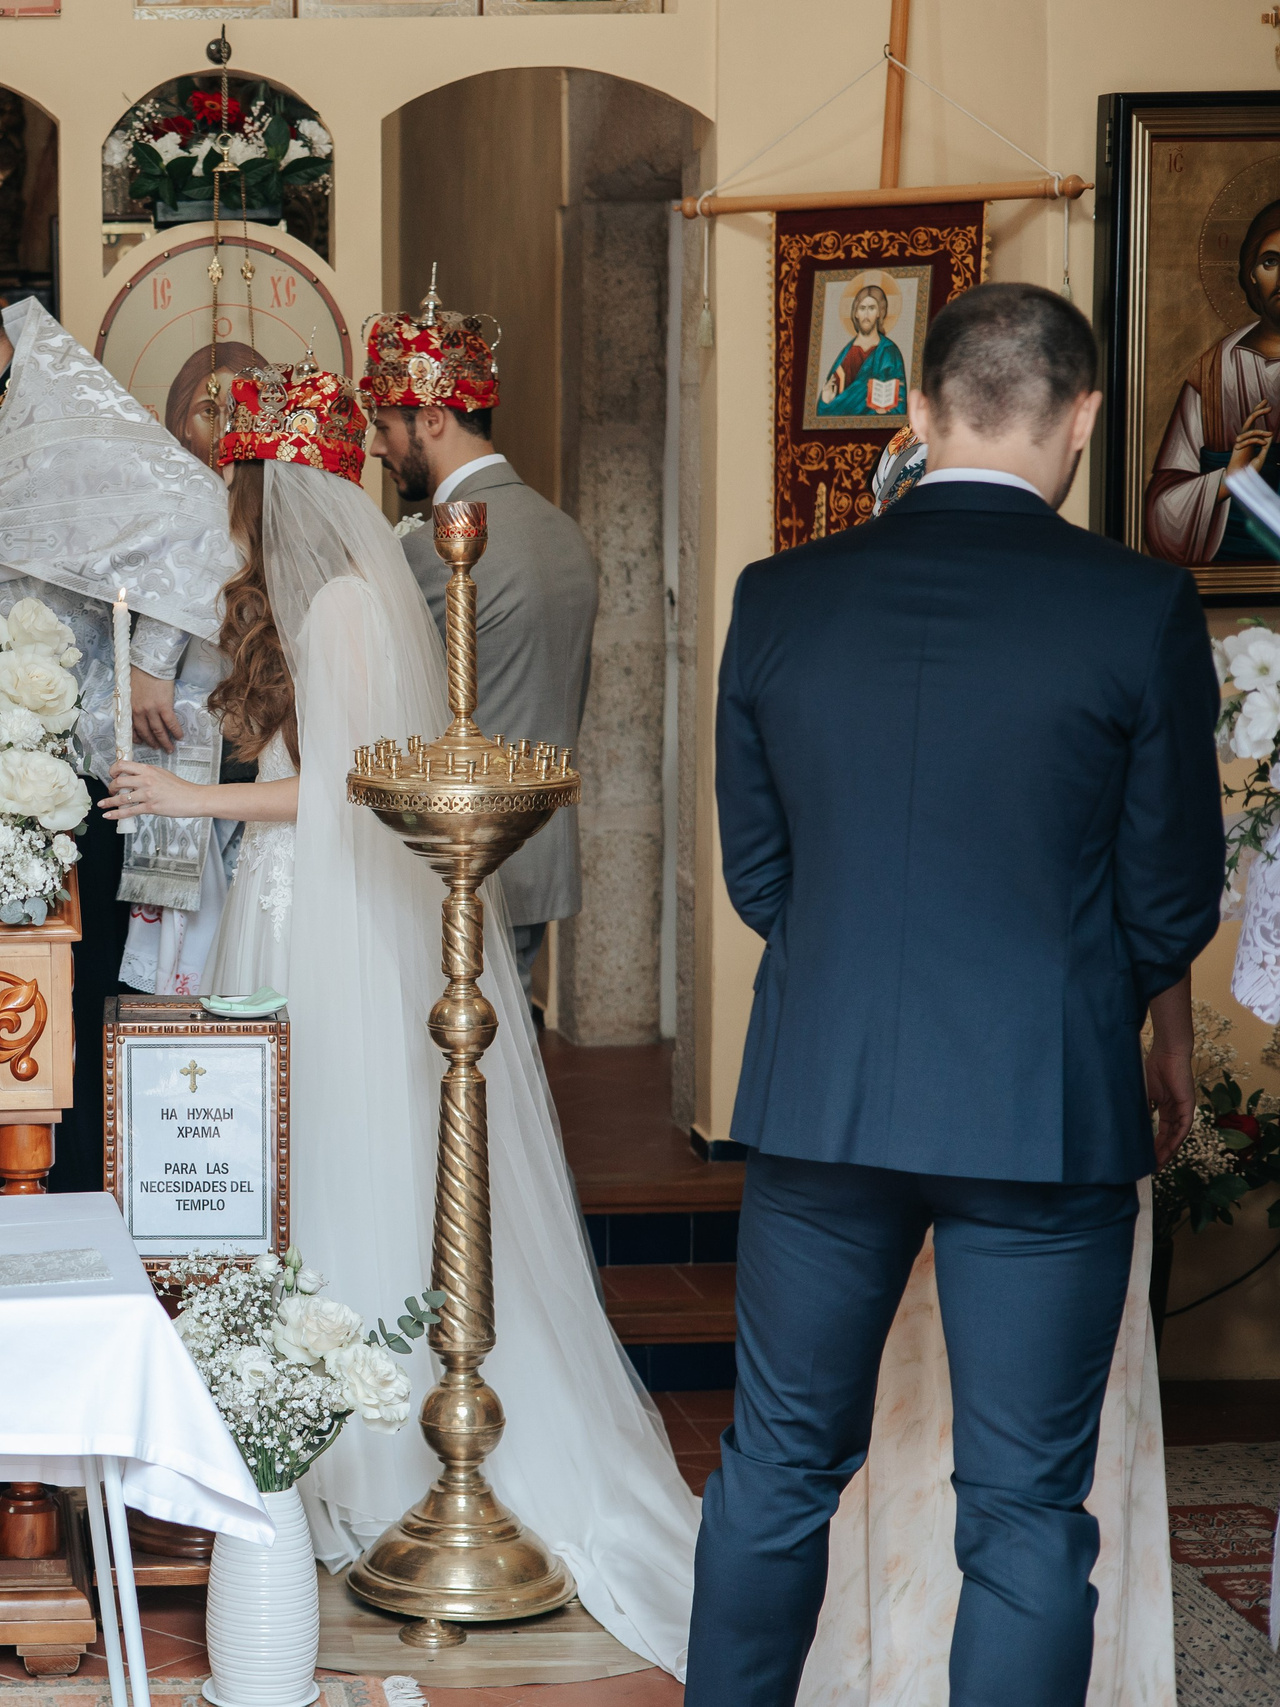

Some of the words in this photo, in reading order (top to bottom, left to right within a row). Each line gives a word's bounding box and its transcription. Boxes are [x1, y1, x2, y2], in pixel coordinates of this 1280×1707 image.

[160, 1108, 178, 1120] НА
[187, 1108, 234, 1122] НУЖДЫ
[176, 1126, 221, 1139] ХРАМА
[164, 1163, 197, 1175] PARA
[206, 1163, 229, 1175] LAS
[140, 1180, 227, 1193] NECESIDADES
[230, 1180, 254, 1193] DEL
[175, 1198, 226, 1211] TEMPLO
